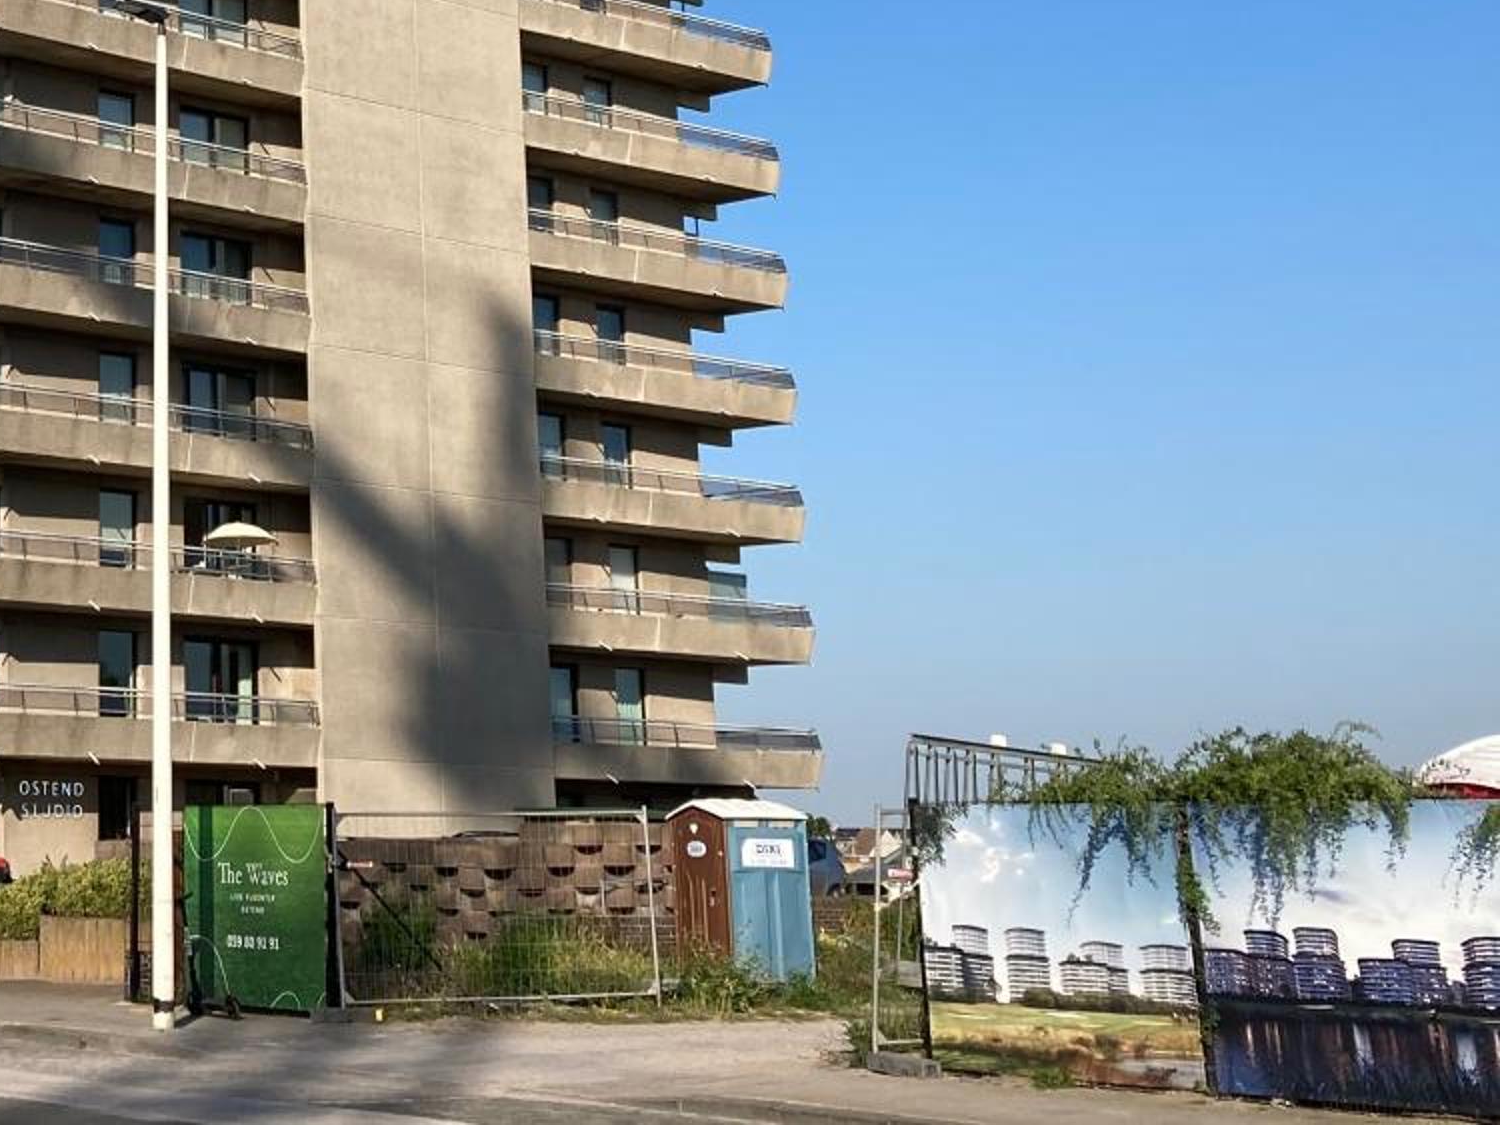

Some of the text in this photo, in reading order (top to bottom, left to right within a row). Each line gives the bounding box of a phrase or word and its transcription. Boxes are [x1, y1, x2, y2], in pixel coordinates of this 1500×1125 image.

[19, 780, 85, 797] OSTEND
[21, 802, 84, 818] STUDIO
[217, 862, 289, 886] The Waves
